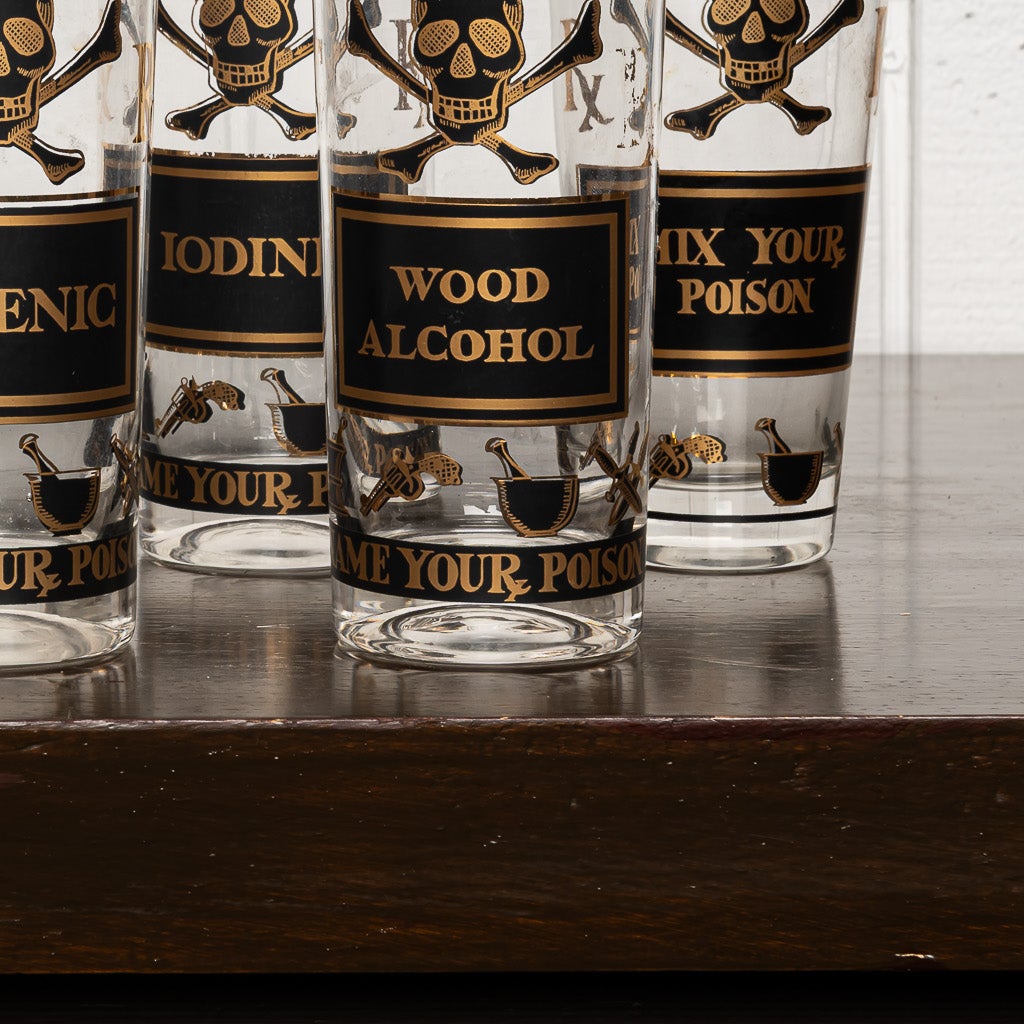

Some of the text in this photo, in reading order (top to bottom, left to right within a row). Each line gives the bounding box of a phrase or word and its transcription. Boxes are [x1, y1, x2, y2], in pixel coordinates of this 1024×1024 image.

[389, 266, 550, 304] WOOD
[677, 278, 815, 315] POISON
[357, 319, 595, 363] ALCOHOL
[335, 531, 390, 585] AME
[538, 536, 644, 592] POISON
